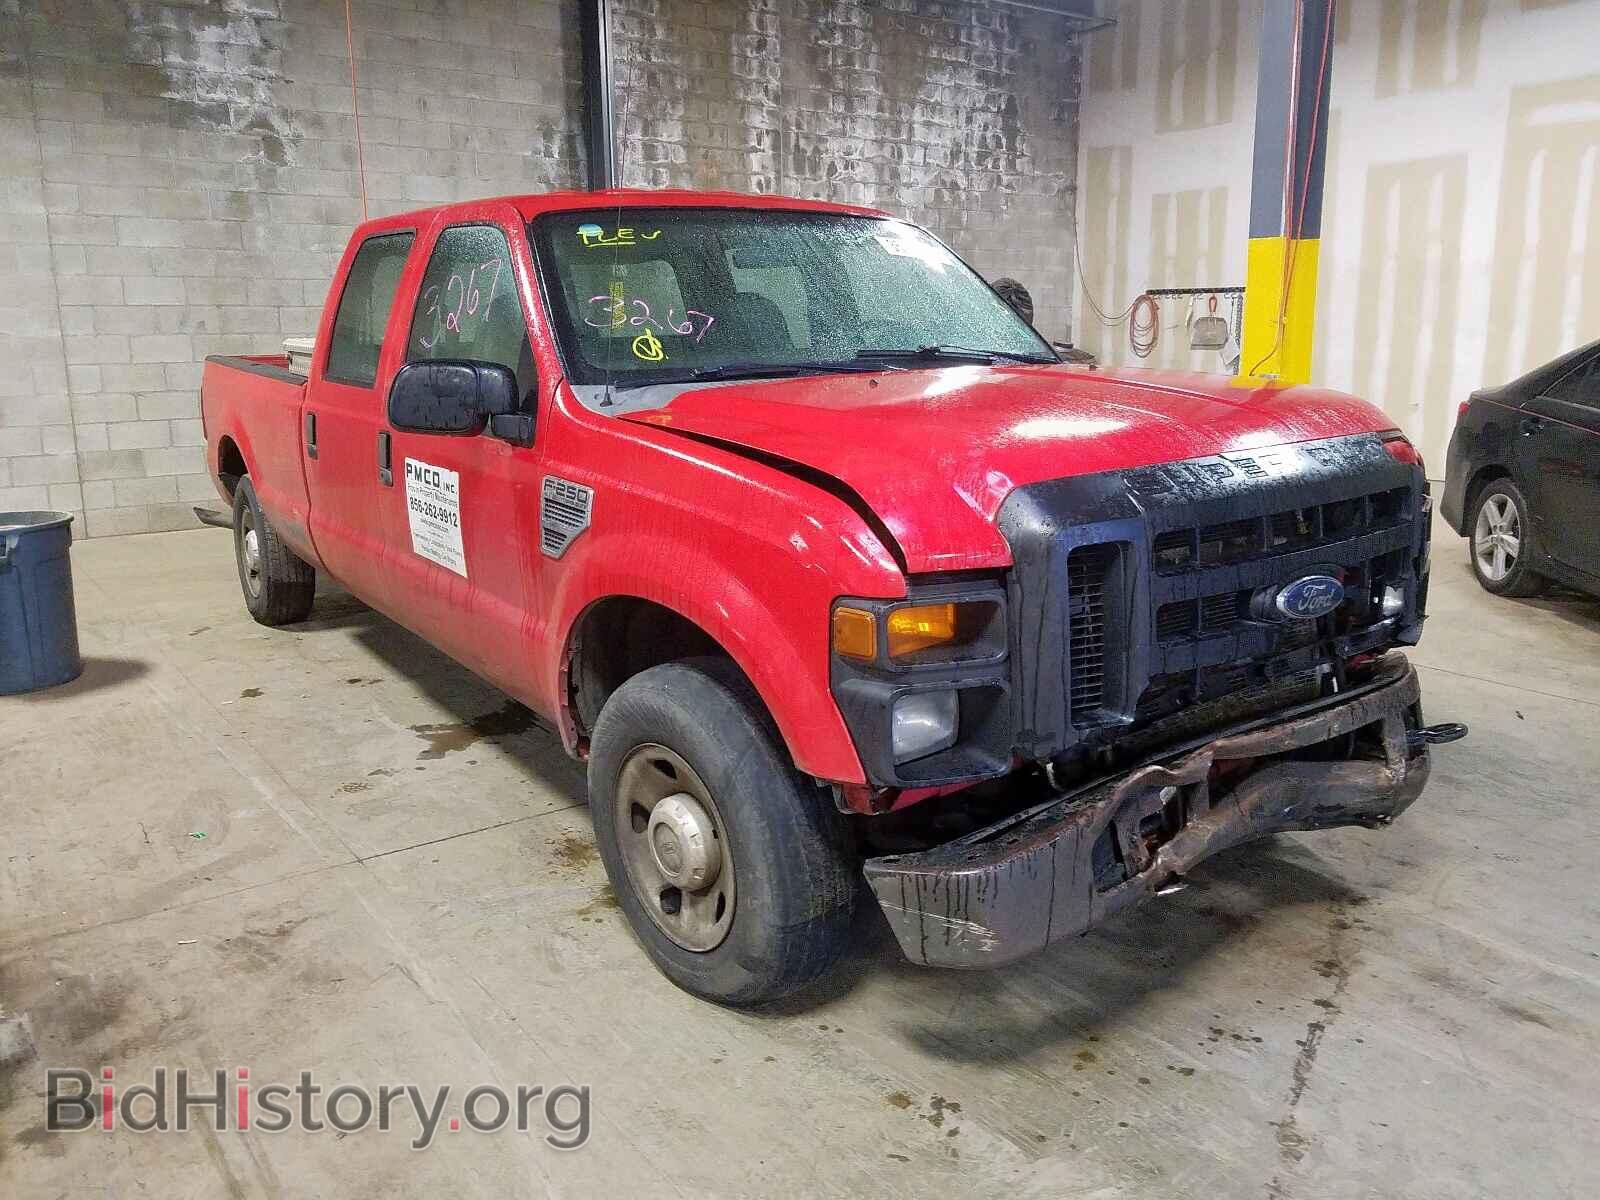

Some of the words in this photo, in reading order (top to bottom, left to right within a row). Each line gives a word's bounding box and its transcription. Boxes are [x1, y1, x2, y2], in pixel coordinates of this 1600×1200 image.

[419, 258, 502, 349] 3267
[584, 295, 715, 344] 3267
[410, 496, 458, 528] 856-262-9912
[1298, 584, 1336, 611] Ford
